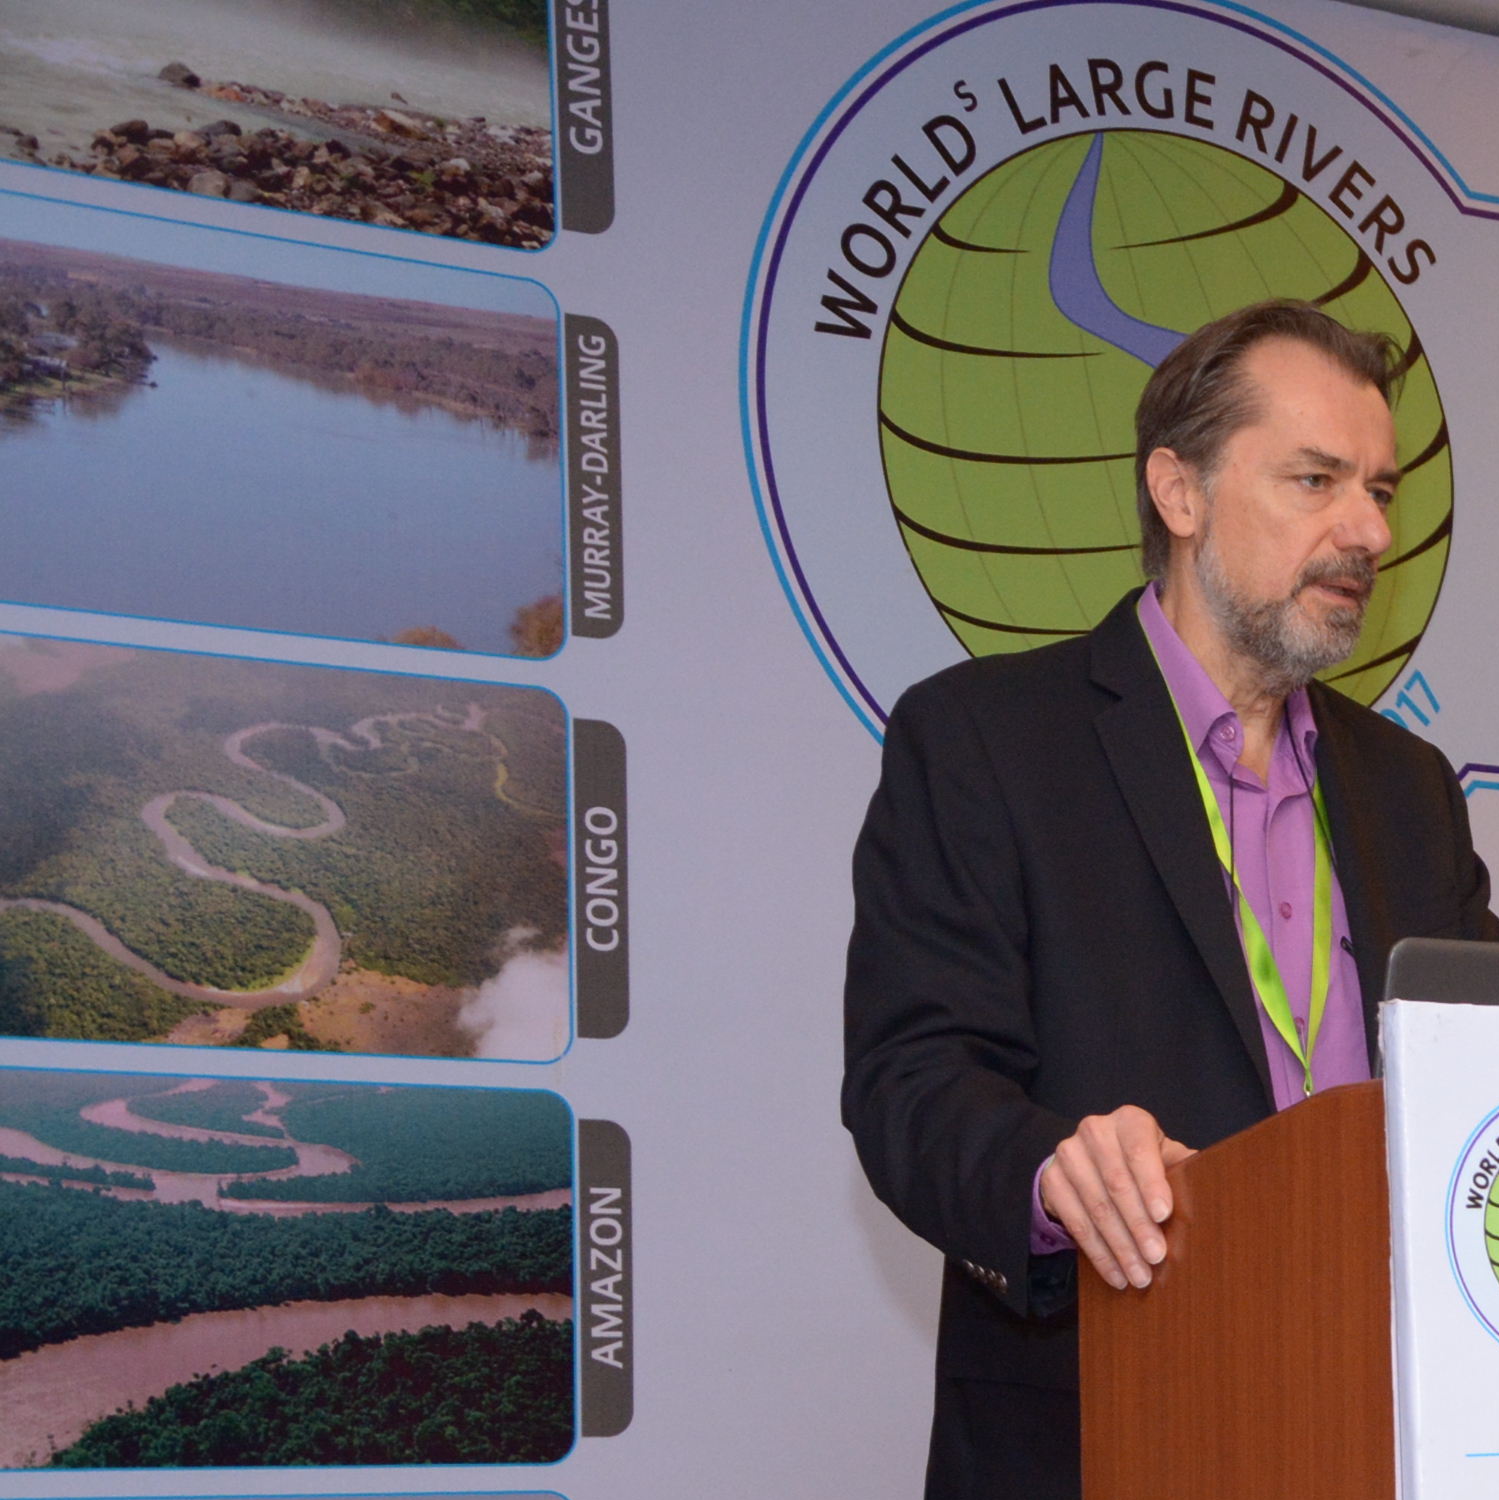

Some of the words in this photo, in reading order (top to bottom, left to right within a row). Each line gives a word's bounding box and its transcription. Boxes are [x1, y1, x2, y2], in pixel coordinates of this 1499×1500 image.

[997, 58, 1217, 136] LARGE
[1235, 89, 1436, 285] RIVERS
[579, 333, 612, 620] MURRAY-DARLING
[1380, 668, 1440, 730] 17
[585, 805, 619, 953] CONGO
[590, 1186, 624, 1370] AMAZON
